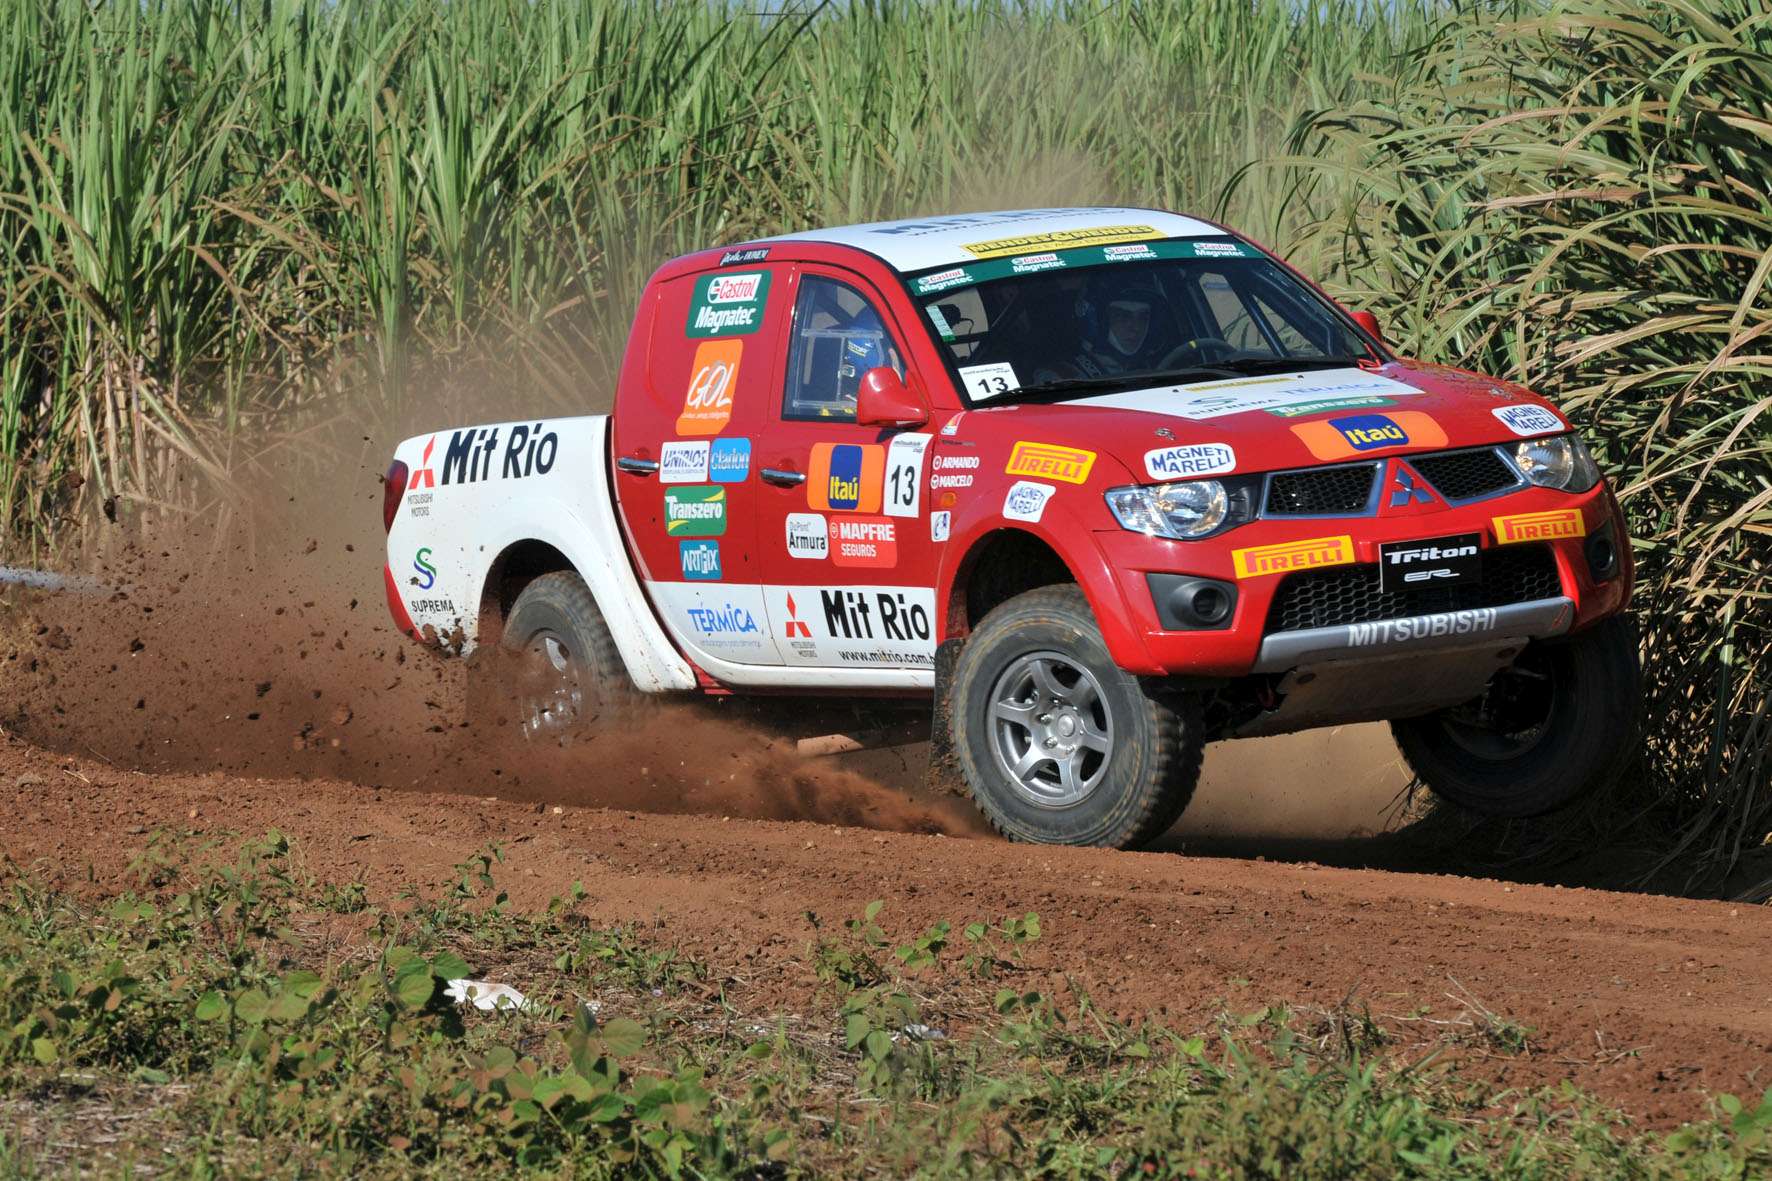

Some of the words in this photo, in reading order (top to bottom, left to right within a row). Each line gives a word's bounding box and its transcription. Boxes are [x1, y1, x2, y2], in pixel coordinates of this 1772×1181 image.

[1104, 251, 1158, 262] Magnatec
[1115, 244, 1145, 254] Castrol
[1195, 249, 1246, 257] Magnatec
[1013, 260, 1067, 273] Magnatec
[1022, 255, 1056, 264] Castrol
[919, 275, 974, 293] Magnatec
[929, 269, 962, 283] Castrol
[719, 279, 757, 299] Castrol
[694, 306, 757, 334] Magnatec
[687, 363, 735, 410] GOL
[977, 376, 1009, 393] 13
[1345, 424, 1404, 445] Itaú
[441, 428, 499, 485] Mit
[502, 423, 558, 479] Rio
[942, 456, 980, 469] ARMANDO
[1012, 446, 1089, 478] PIRELLI
[829, 476, 860, 501] Itaú
[890, 464, 915, 506] 13
[939, 475, 974, 488] MARCELO
[664, 495, 723, 521] Transzero
[840, 522, 896, 542] MAPFRE
[1505, 512, 1578, 541] PIRELLI
[789, 531, 827, 550] Armura
[841, 543, 877, 557] SEGUROS
[1244, 540, 1343, 574] PIRELLI
[1385, 545, 1478, 565] Triton
[411, 599, 454, 613] SUPREMA
[820, 589, 875, 639] Mit
[877, 593, 930, 641] Rio
[1348, 607, 1498, 647] MITSUBISHI
